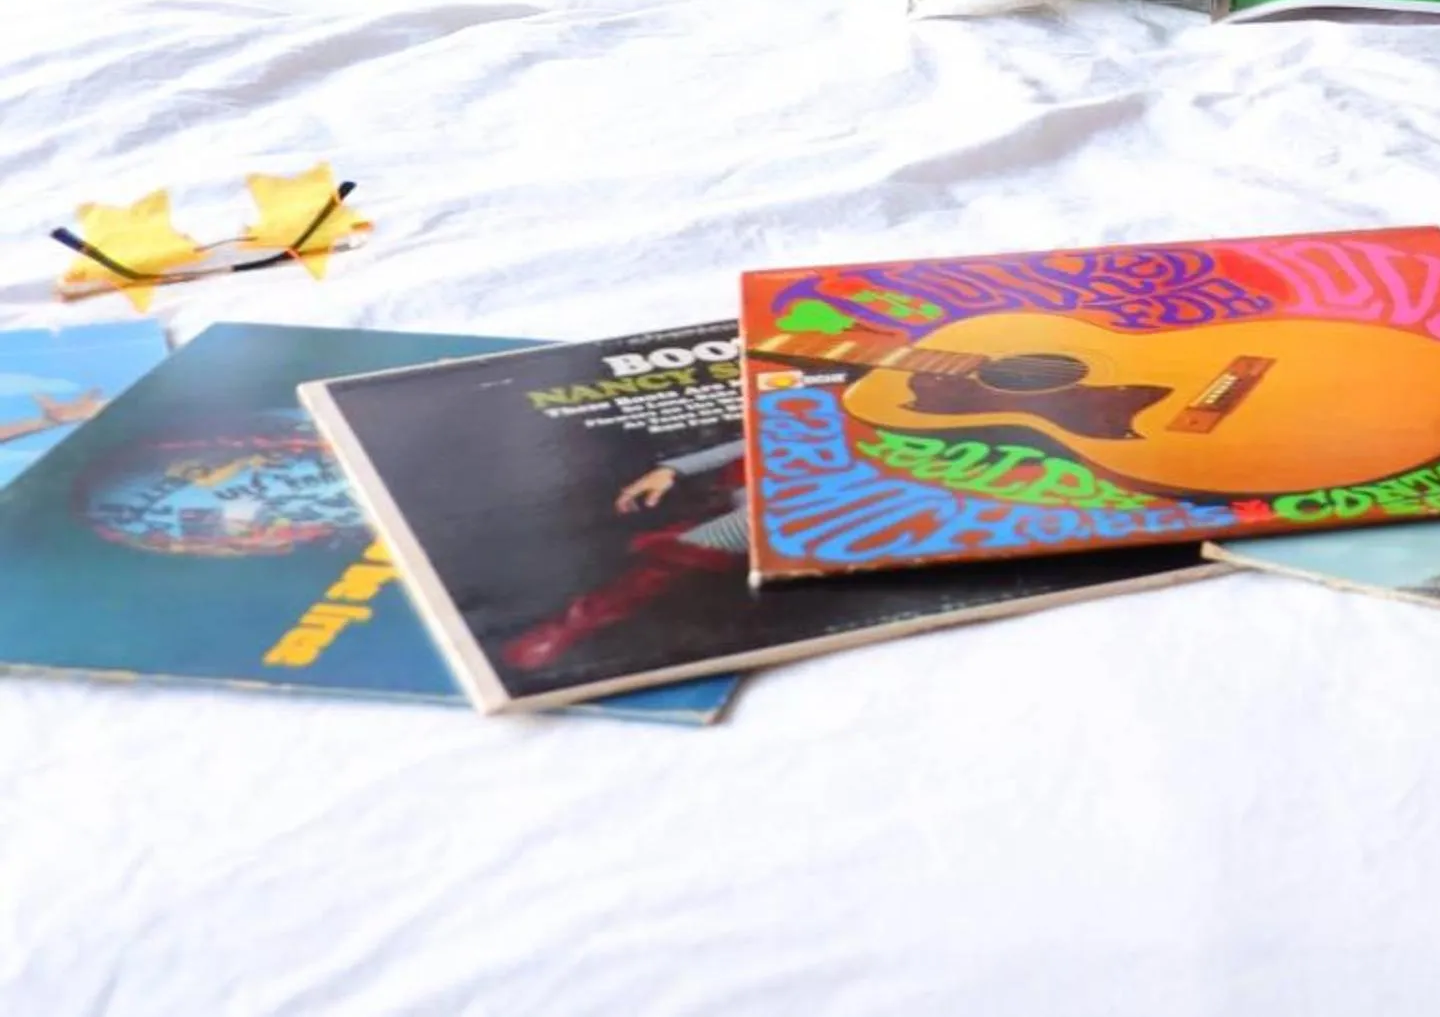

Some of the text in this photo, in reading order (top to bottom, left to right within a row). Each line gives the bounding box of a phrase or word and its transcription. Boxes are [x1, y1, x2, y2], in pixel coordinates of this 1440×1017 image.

[1084, 276, 1275, 329] FOR
[602, 337, 741, 378] BOO
[527, 367, 698, 409] NANCY
